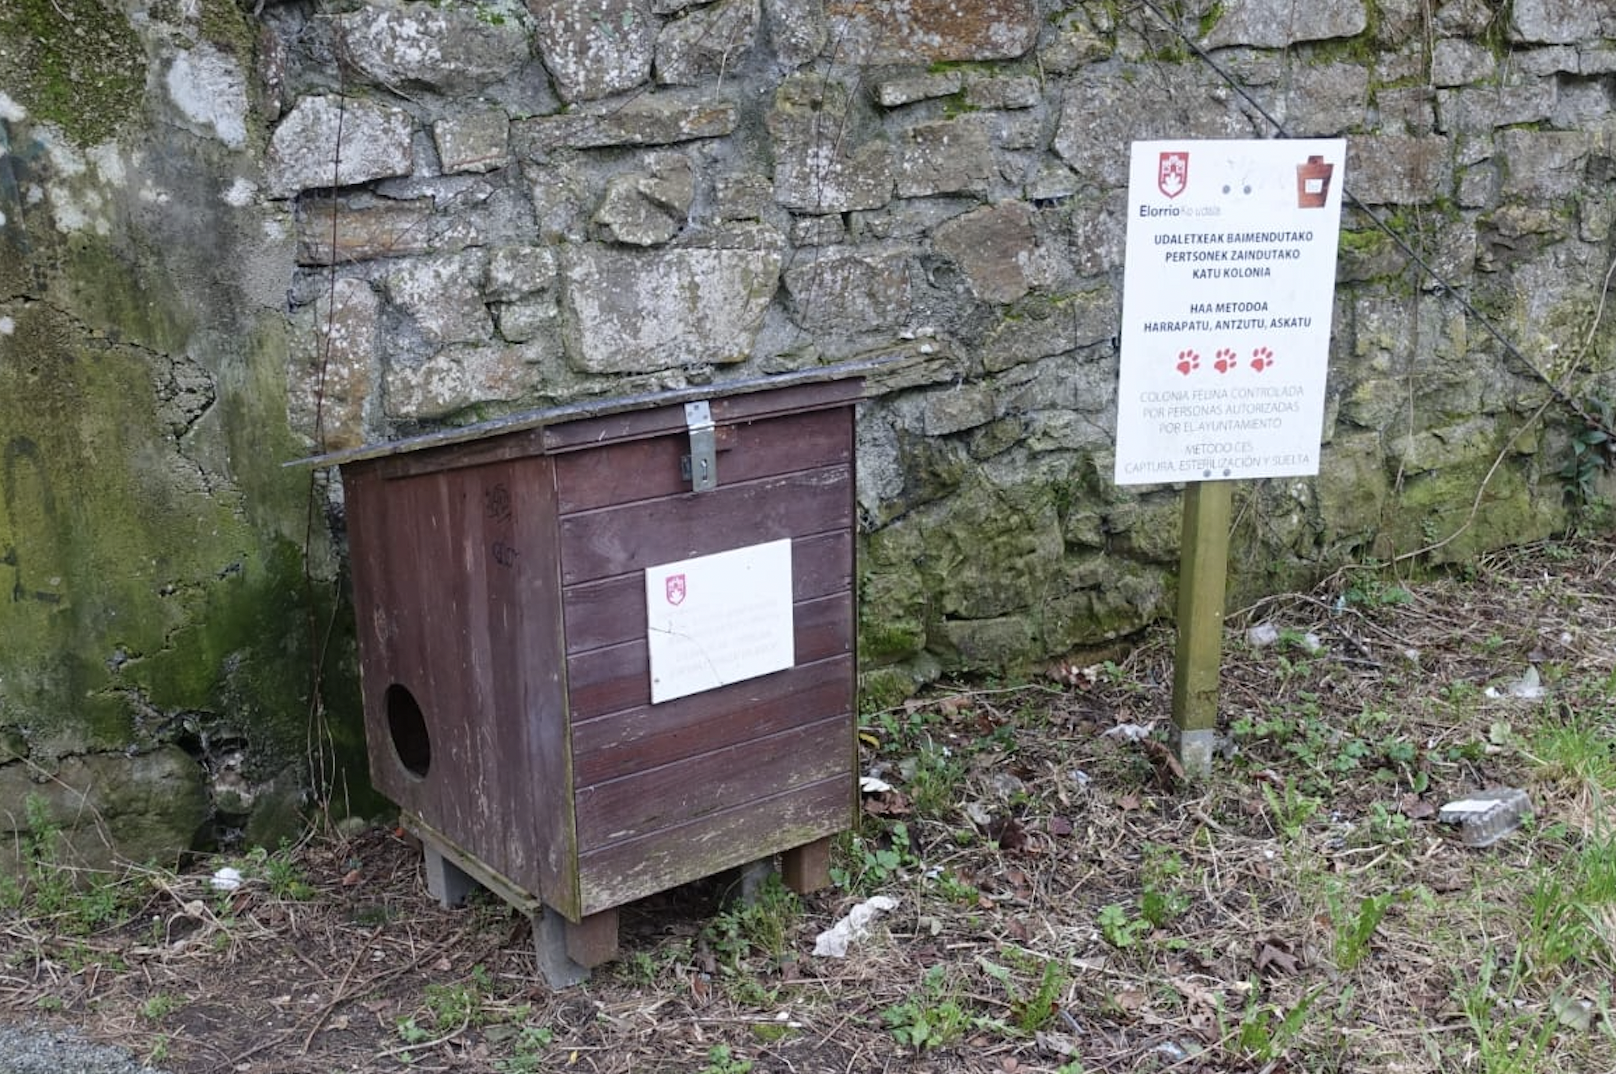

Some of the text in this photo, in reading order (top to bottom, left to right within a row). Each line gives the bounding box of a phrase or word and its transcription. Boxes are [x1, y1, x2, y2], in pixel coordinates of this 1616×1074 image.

[1154, 231, 1313, 245] UDALETXEAK BAIMENDUTAKO
[1165, 249, 1300, 263] PERTSONEK ZAINDUTAKO
[1192, 267, 1271, 279] KATU KOLONIA
[1190, 301, 1268, 314] HAA METODOA
[1143, 317, 1312, 333] HARRAPATU, ANTZUTU, ASKATU
[1140, 385, 1304, 403] COLONIA FELINA CONTROLADA
[1142, 401, 1300, 419] POR PERSONAS AUTORIZADAS
[1159, 417, 1282, 435] POR EL AYUNTAMIENTO
[1272, 454, 1310, 466] SUELTA
